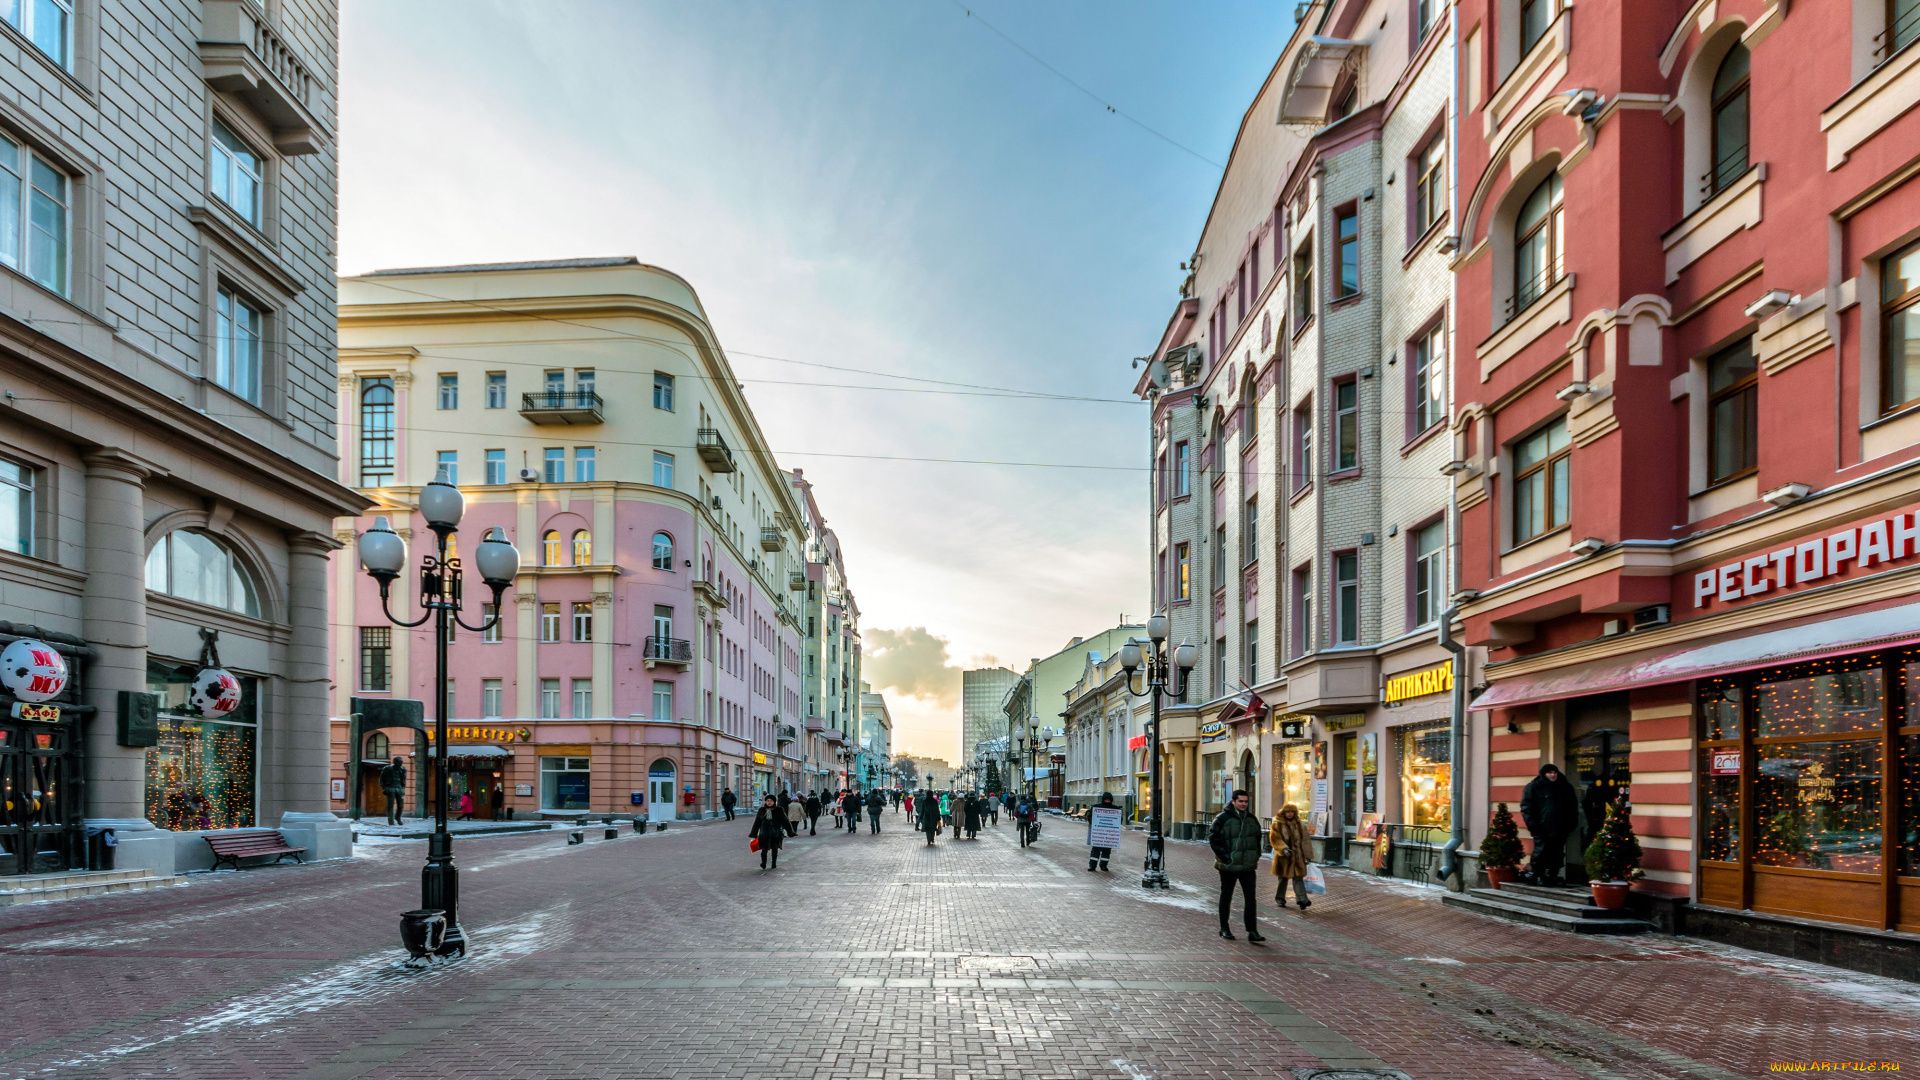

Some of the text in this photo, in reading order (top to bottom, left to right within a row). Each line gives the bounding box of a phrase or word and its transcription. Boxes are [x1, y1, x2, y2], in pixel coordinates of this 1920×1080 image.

[1695, 509, 1920, 608] РЕСТОРАН
[1385, 660, 1454, 703] АНТИКВАРЪ
[23, 708, 58, 719] КАФЕ
[427, 726, 515, 742] ОТМЕЙСТЕР
